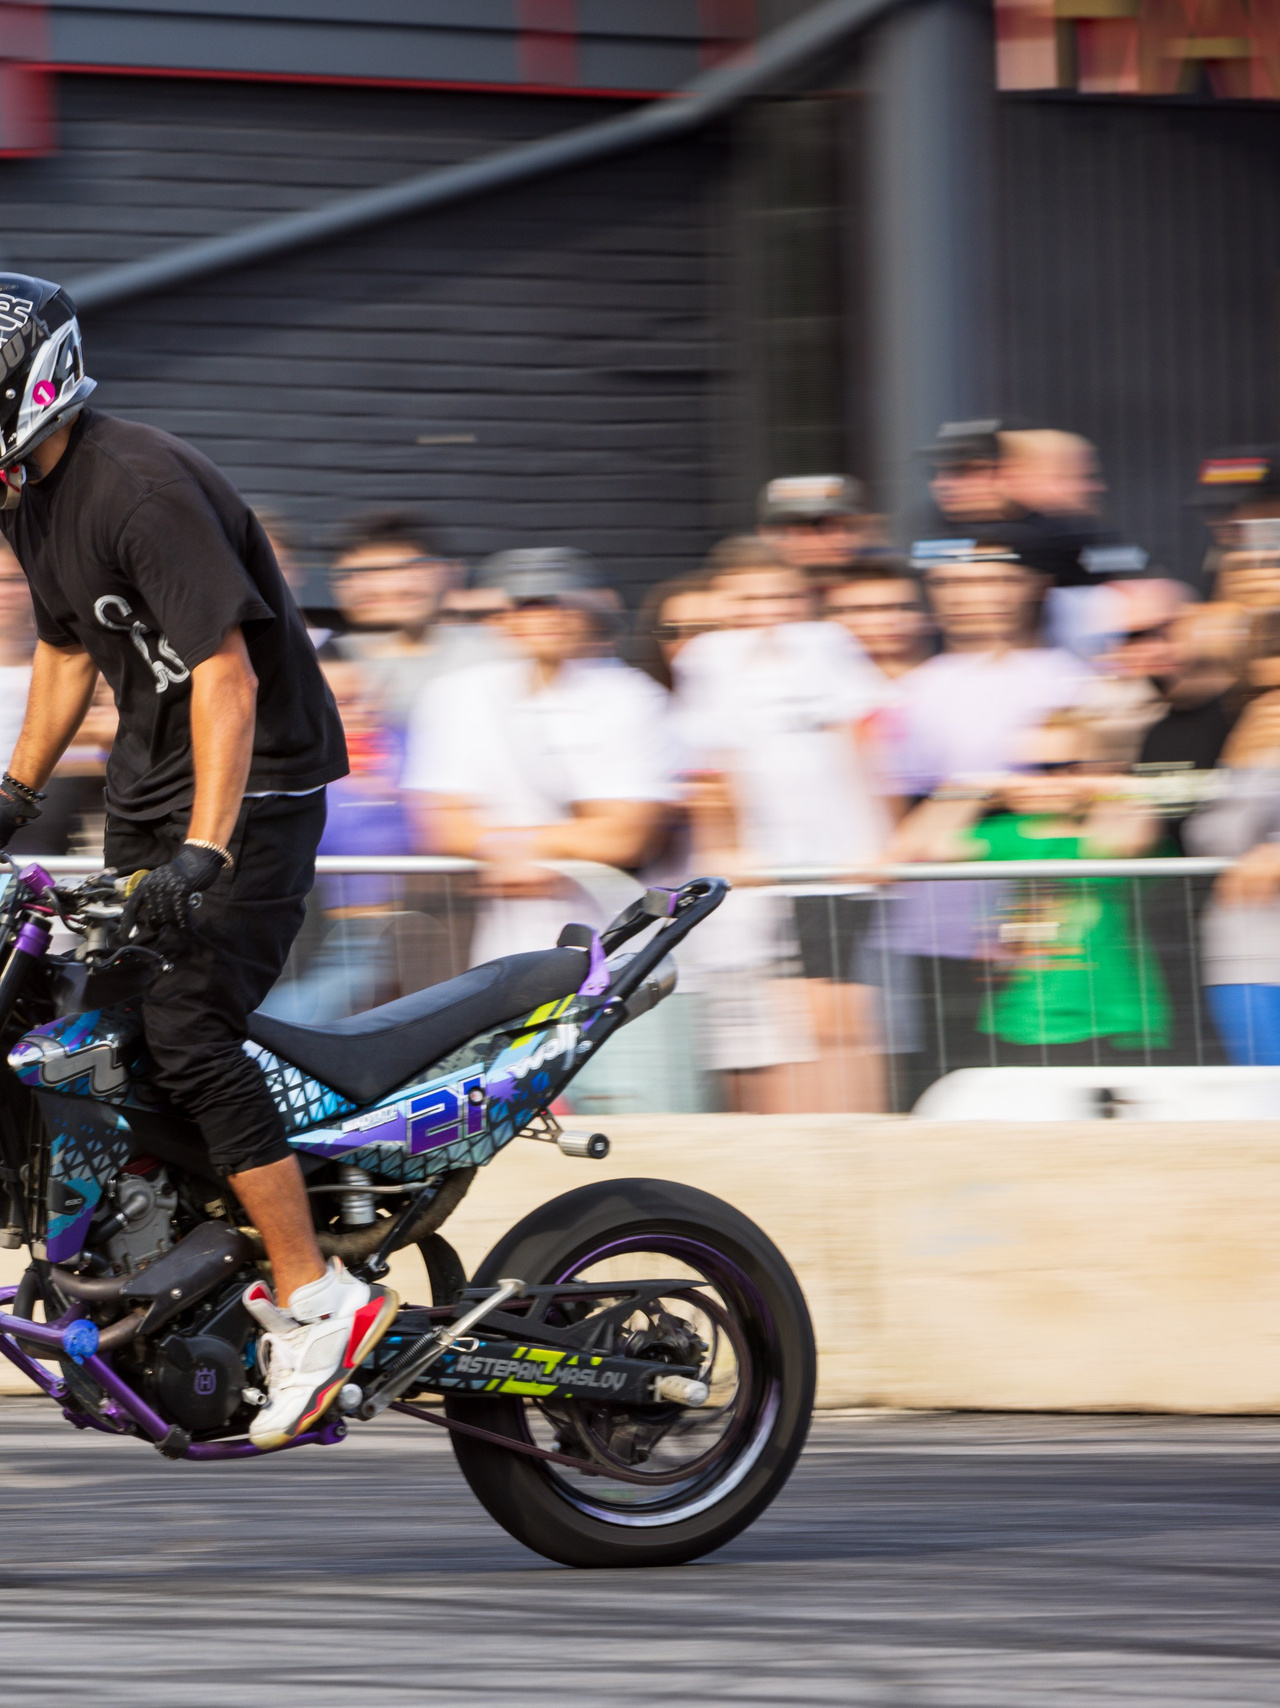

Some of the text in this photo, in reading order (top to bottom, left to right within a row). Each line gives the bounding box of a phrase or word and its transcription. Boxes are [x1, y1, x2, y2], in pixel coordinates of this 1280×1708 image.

[37, 386, 51, 402] 1
[406, 1073, 488, 1158] 21
[456, 1354, 628, 1391] #STEPAN_MASLOV
